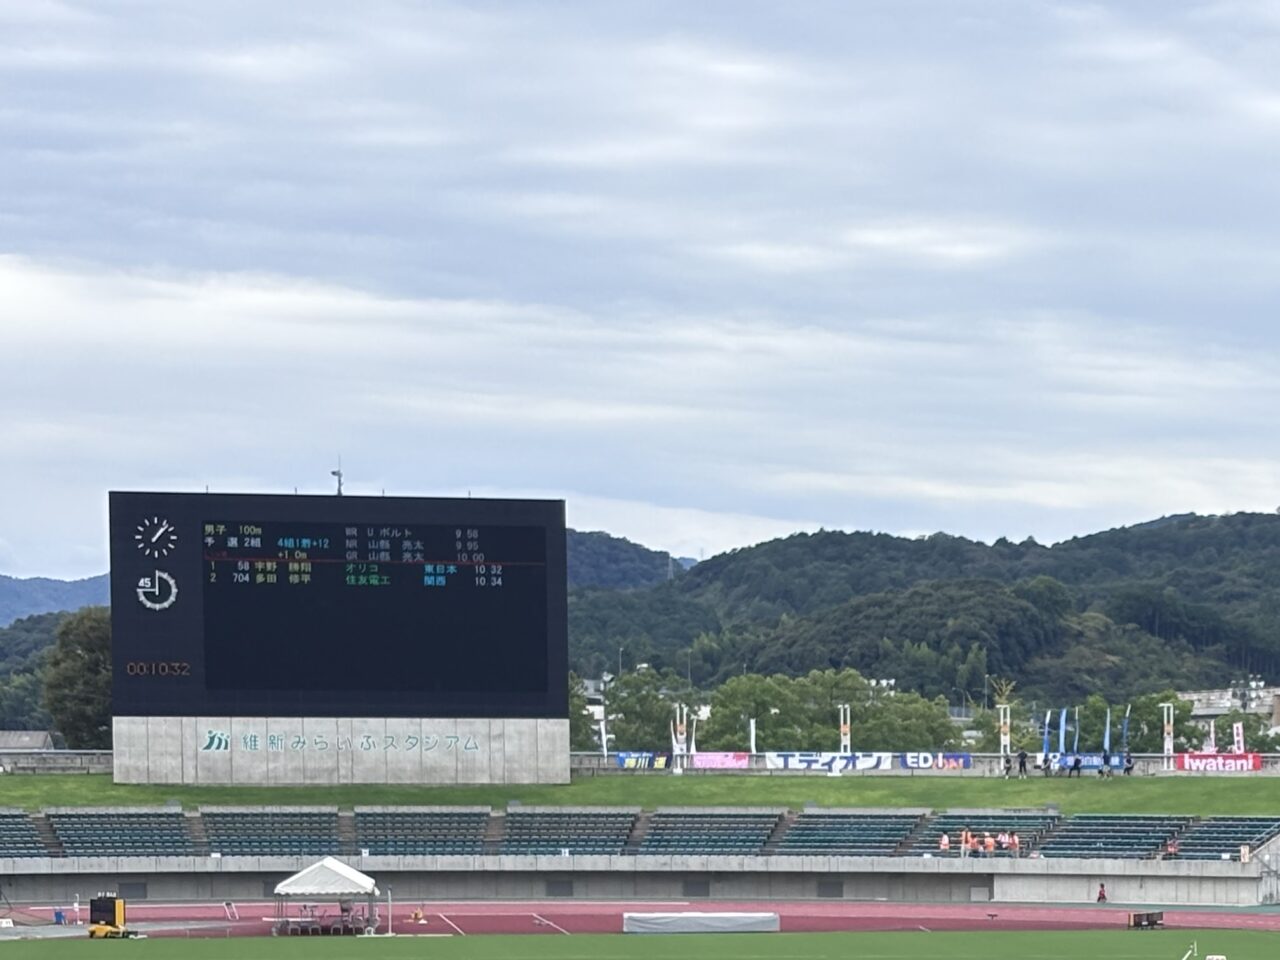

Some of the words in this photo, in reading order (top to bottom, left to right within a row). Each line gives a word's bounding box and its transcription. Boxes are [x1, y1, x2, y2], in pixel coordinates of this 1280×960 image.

[204, 524, 227, 535] 男子
[239, 525, 262, 535] 100m
[424, 564, 457, 574] 東日本
[232, 572, 250, 583] 704
[346, 574, 391, 585] 住友電工
[241, 734, 480, 752] 維新みらいふスタジアム
[1183, 753, 1254, 771] Iwatani
